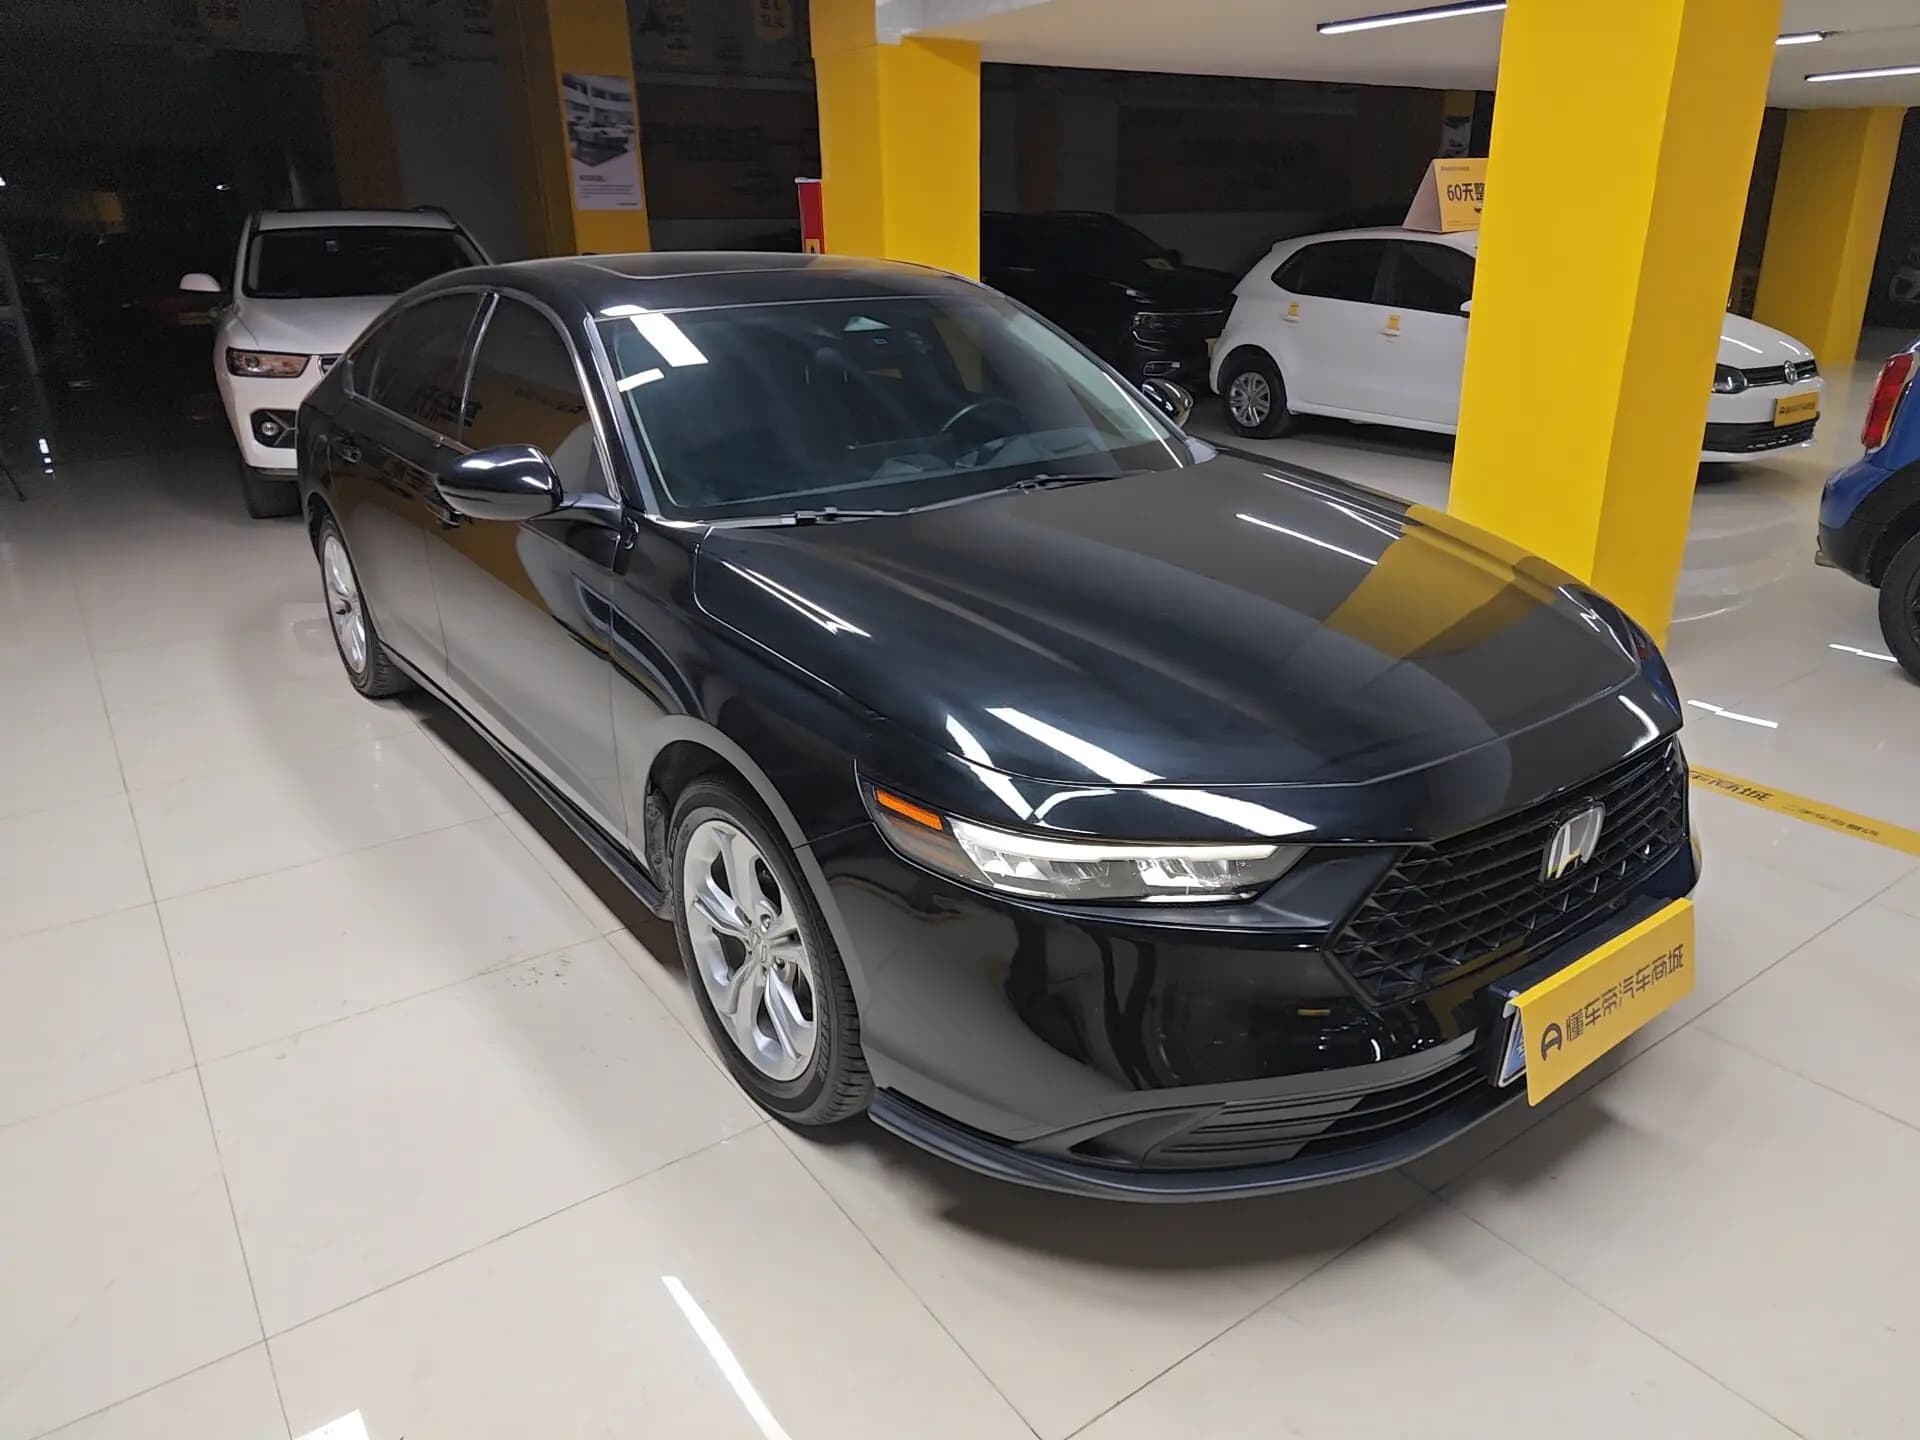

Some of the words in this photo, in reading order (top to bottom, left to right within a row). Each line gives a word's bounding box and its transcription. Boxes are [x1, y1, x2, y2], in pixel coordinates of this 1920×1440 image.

[1565, 943, 1684, 1042] 懂车帝汽车商城
